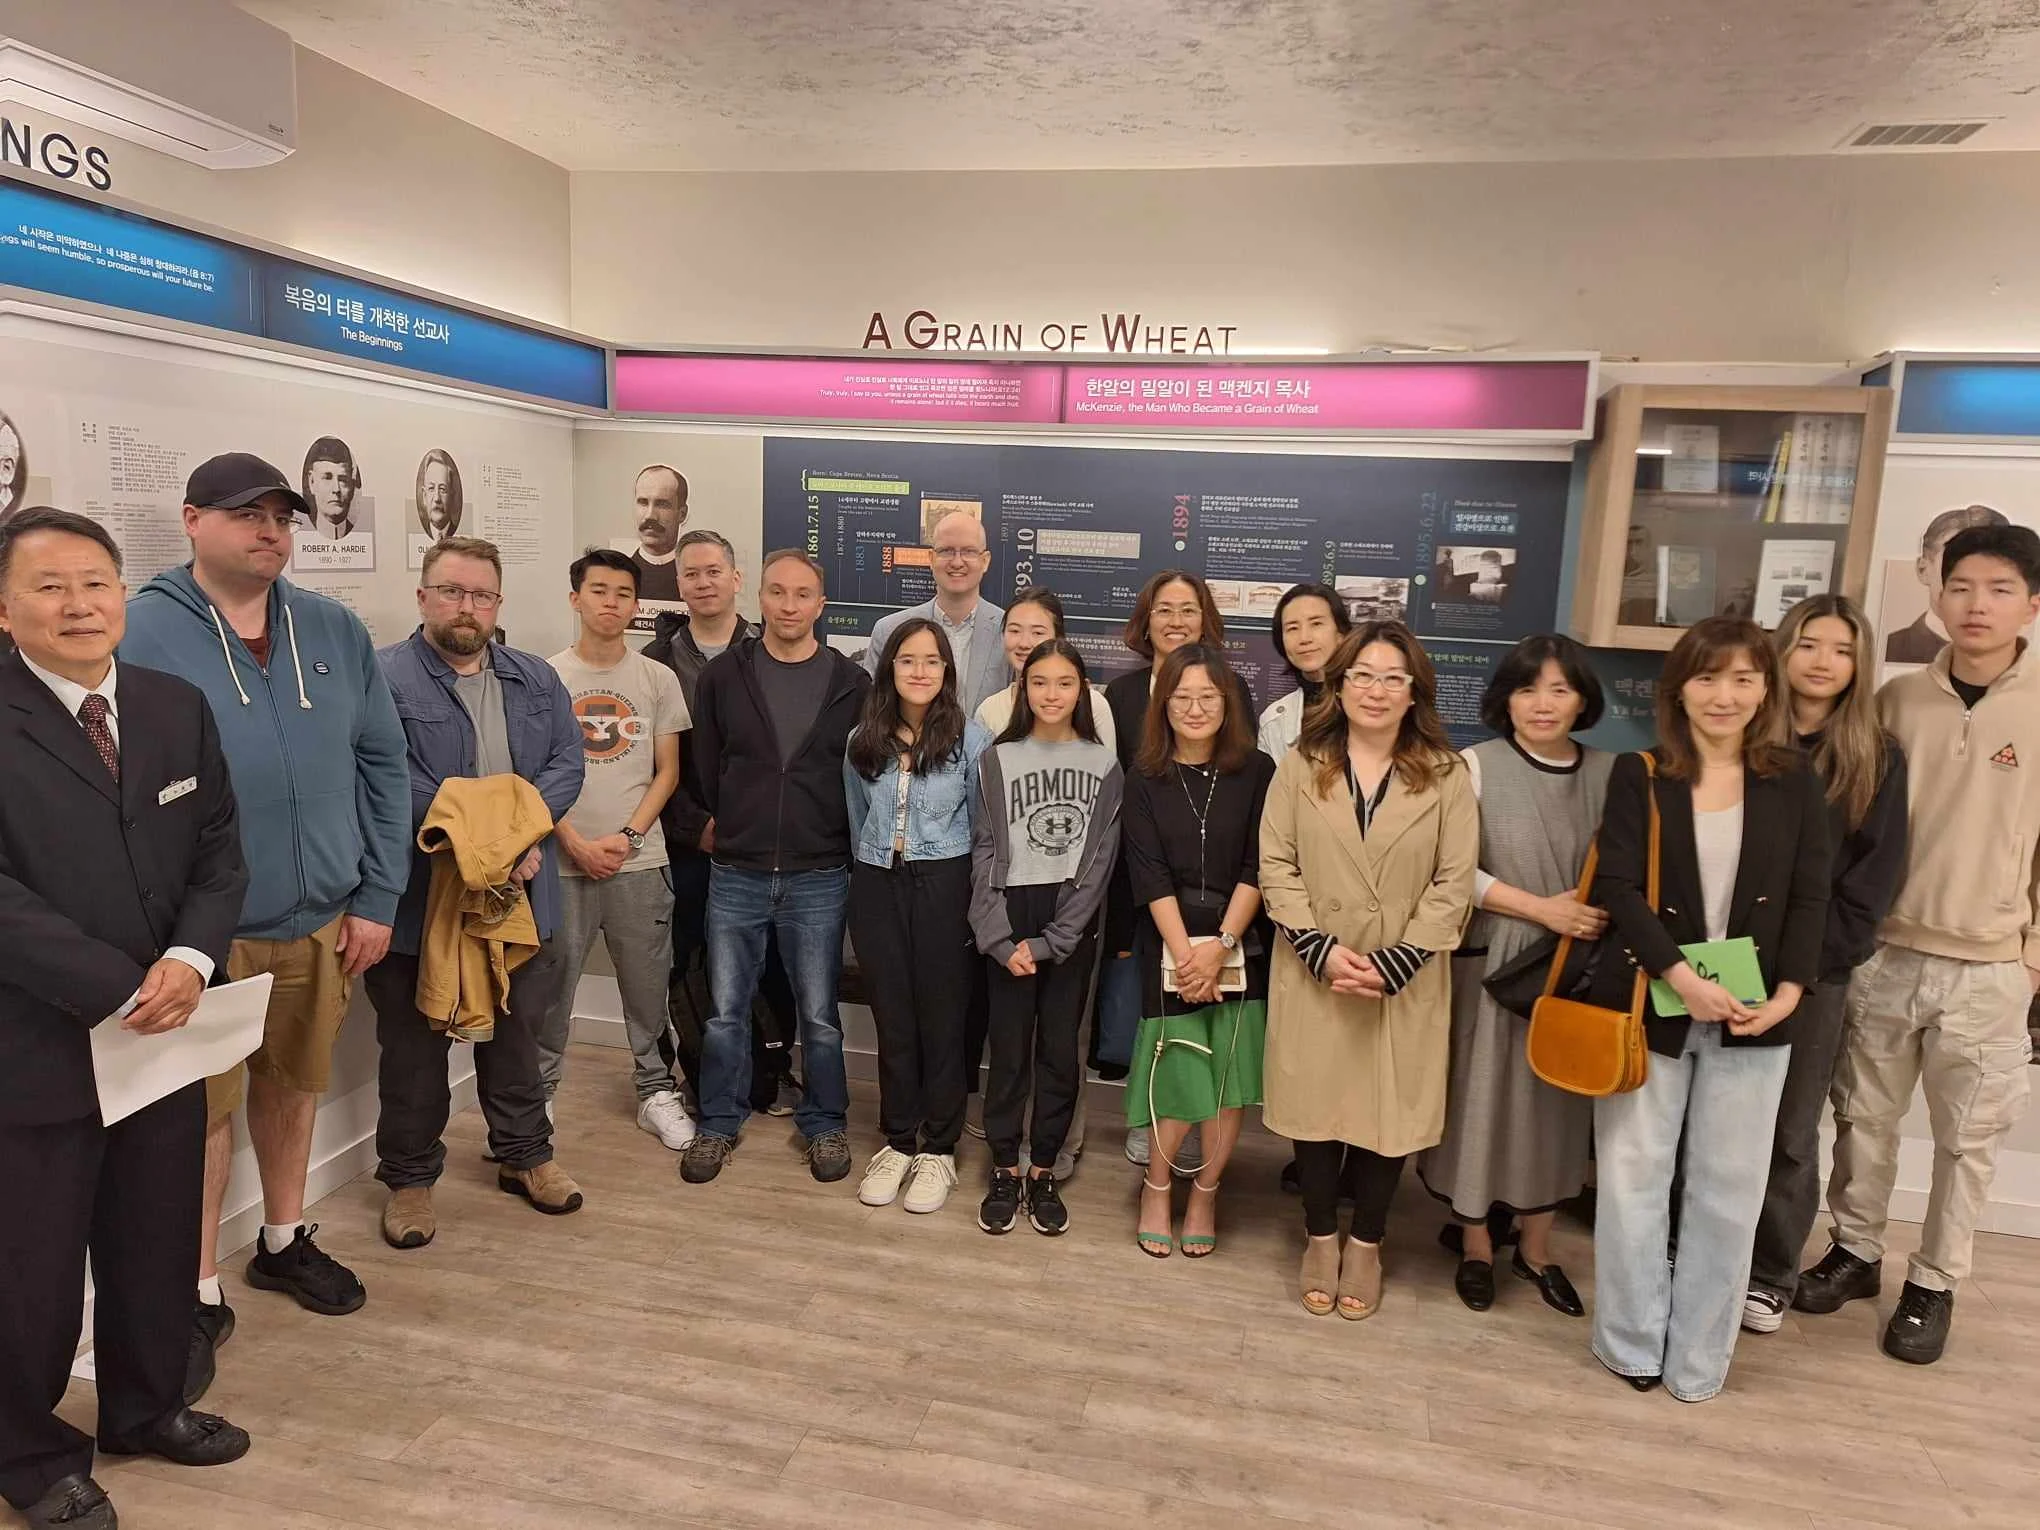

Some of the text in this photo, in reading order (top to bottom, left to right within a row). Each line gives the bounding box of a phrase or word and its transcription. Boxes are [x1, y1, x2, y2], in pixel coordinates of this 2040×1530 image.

[1, 117, 112, 191] NGS
[21, 238, 36, 249] will
[37, 243, 60, 255] seem
[96, 257, 106, 266] so
[107, 260, 150, 278] prosperous
[151, 270, 164, 280] will
[165, 274, 182, 285] your
[182, 277, 202, 290] future
[284, 283, 451, 345] 복음의 터를 개척한 선교사
[341, 326, 404, 352] The Beginnings
[862, 310, 1237, 354] A GRAIN OF WHEAT
[1086, 379, 1311, 399] 한알의 밀알이 된 맥켄지 목사
[1076, 401, 1319, 414] McKenzie, the Man Who Became a Grain of Wheat
[1172, 494, 1191, 539] 1894
[301, 544, 331, 553] ROBERT
[341, 545, 367, 553] HARDIE
[855, 545, 865, 571] 1883
[881, 546, 892, 573] 1888
